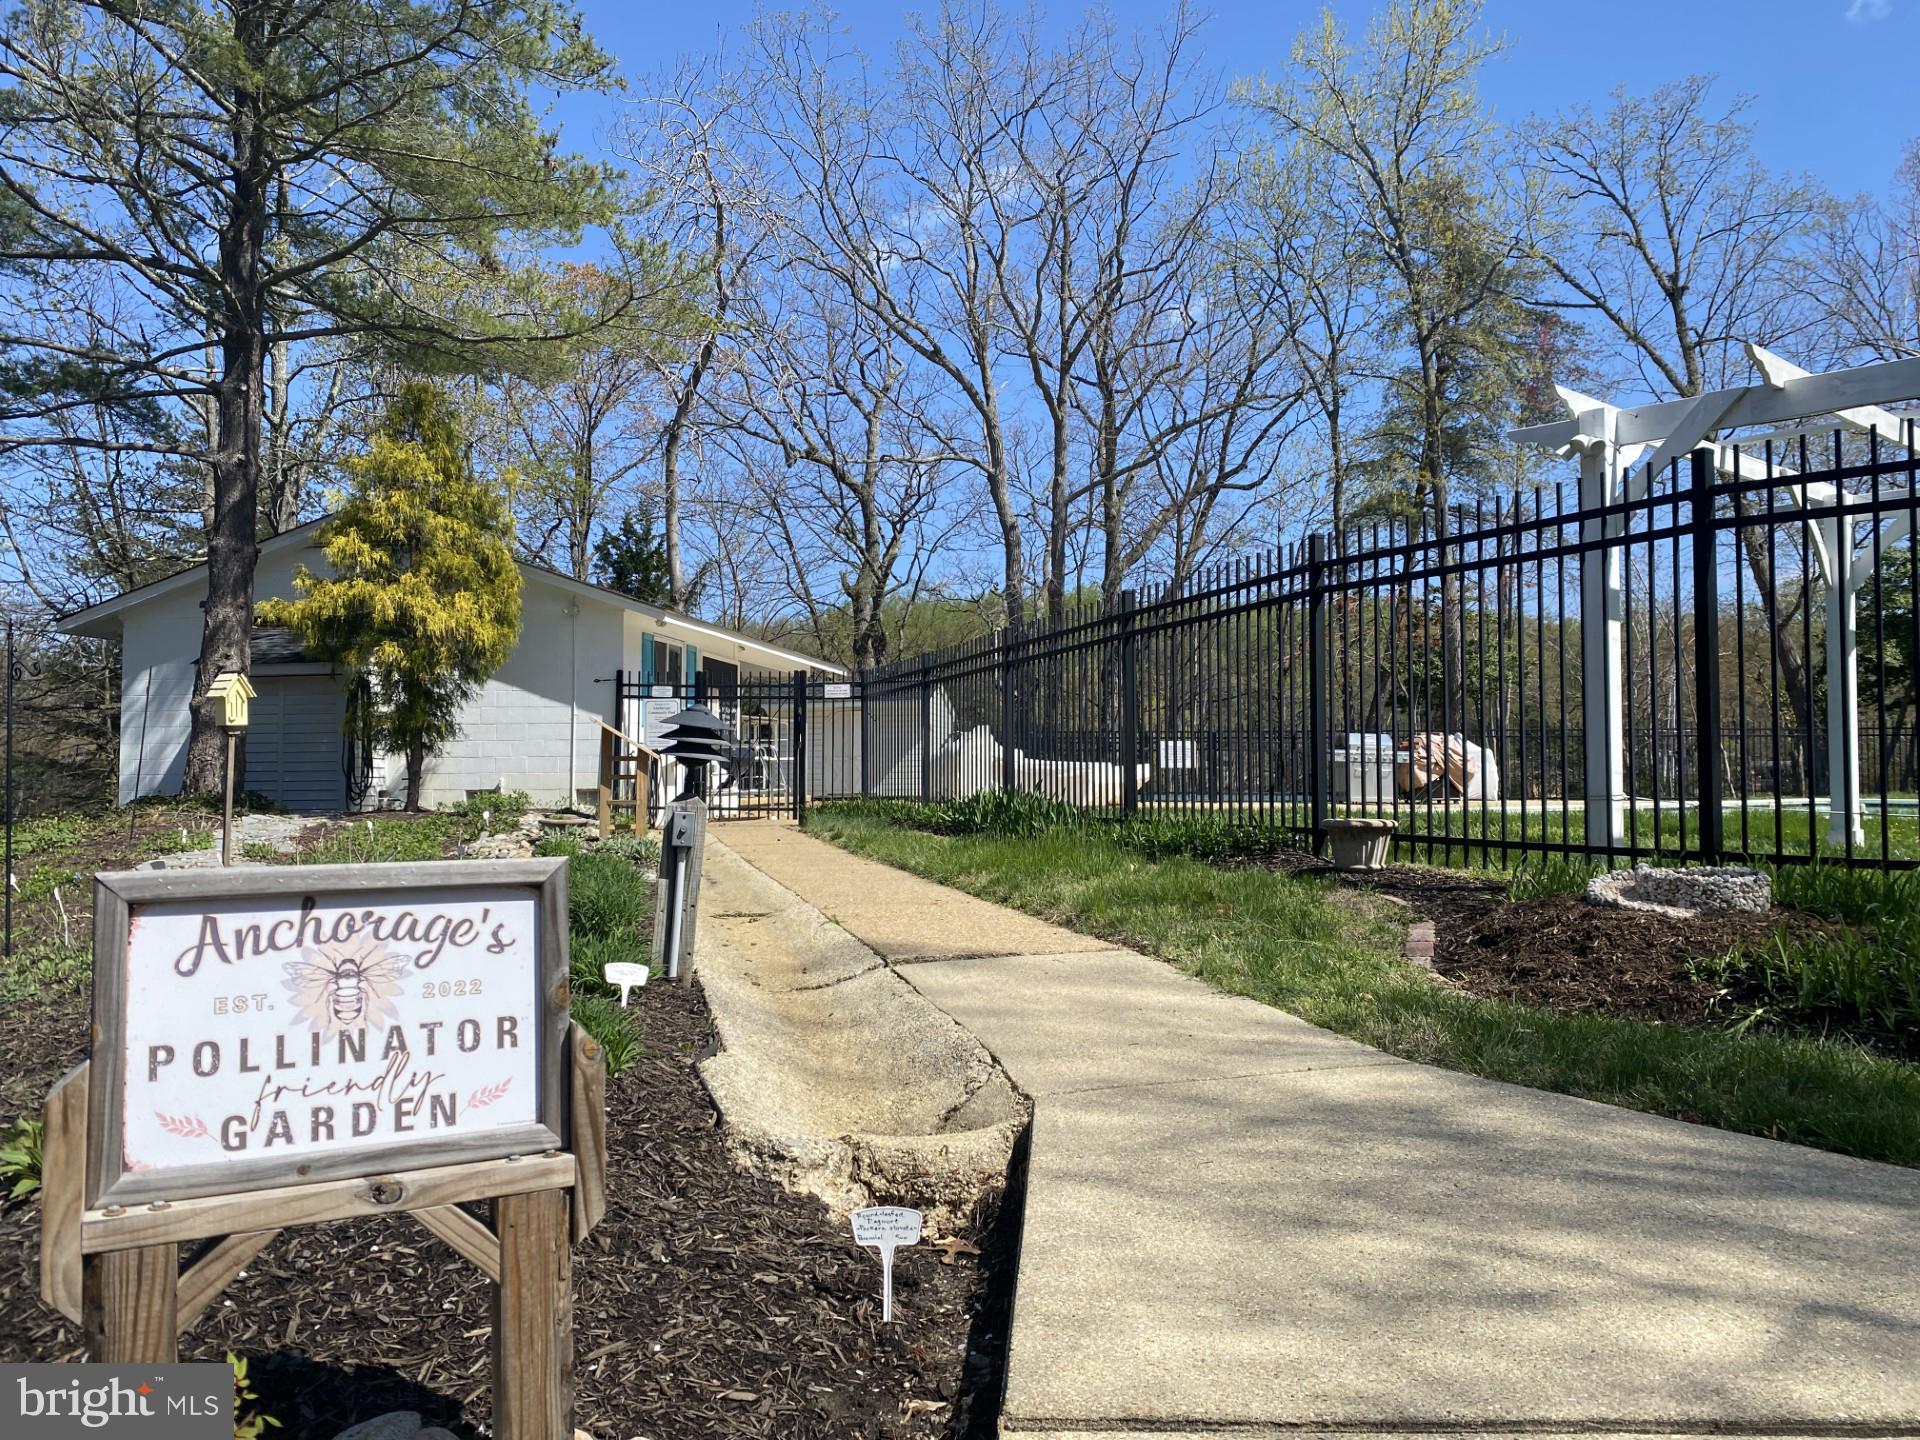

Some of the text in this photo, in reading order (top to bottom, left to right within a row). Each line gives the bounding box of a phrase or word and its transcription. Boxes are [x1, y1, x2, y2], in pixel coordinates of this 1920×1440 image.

[174, 895, 517, 978] Anchorage's
[213, 978, 483, 1015] EST. 2022
[148, 1015, 519, 1082] POLLINATOR
[220, 1091, 457, 1152] GARDEN
[250, 1051, 445, 1131] friendly
